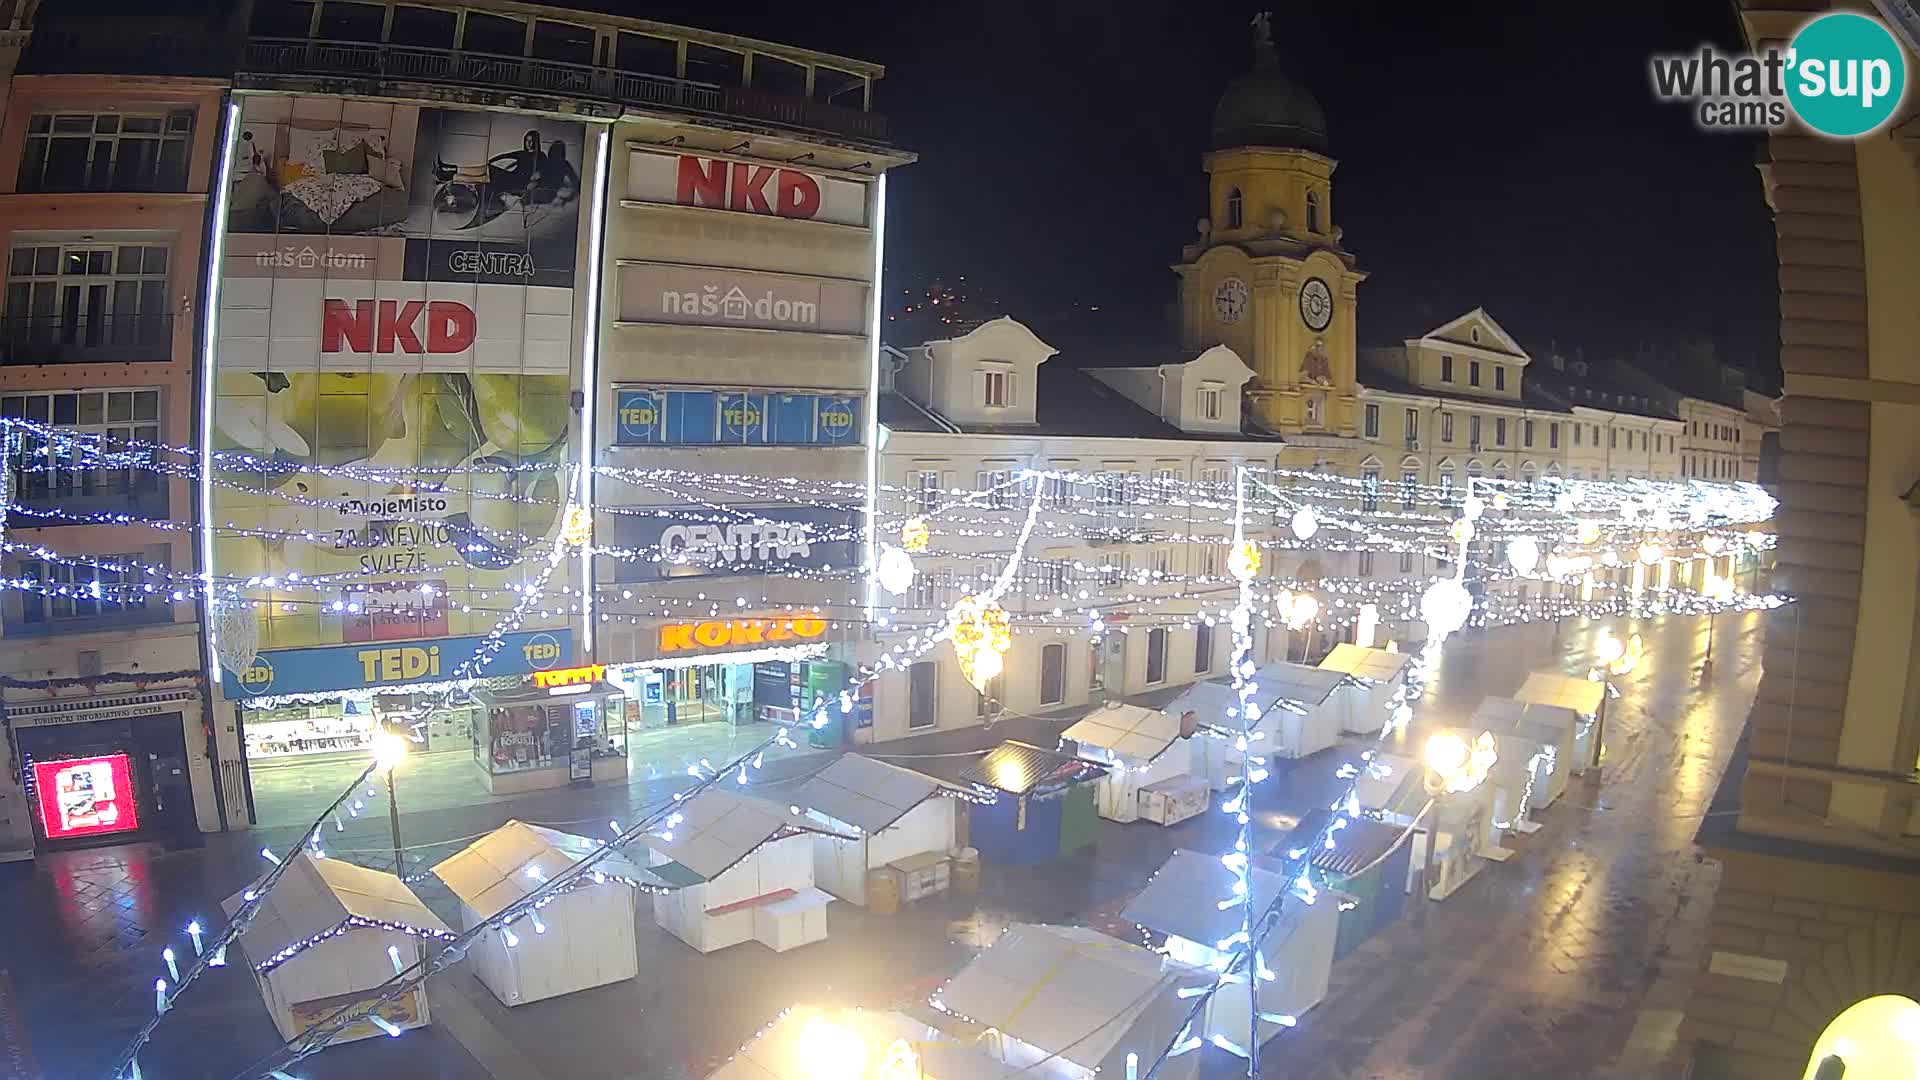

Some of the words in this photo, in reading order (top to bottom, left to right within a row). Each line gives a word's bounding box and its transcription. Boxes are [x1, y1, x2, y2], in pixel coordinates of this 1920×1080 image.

[676, 154, 821, 219] NKD
[256, 246, 295, 269] naš
[319, 247, 367, 269] dom
[448, 250, 536, 278] CENTRA
[661, 285, 719, 317] naš
[754, 290, 817, 323] dom
[321, 297, 478, 354] NKD
[620, 407, 658, 425] TEDi
[724, 409, 760, 426] TEDi
[339, 497, 447, 516] #TvojeMisto
[334, 529, 359, 549] ZA
[366, 525, 450, 548] DNEVNO
[660, 524, 811, 563] CENTRA
[360, 547, 427, 576] SVJEŽE
[659, 612, 828, 653] KORZO
[358, 645, 440, 683] TEDi
[523, 642, 561, 660] TEDi
[533, 663, 606, 688] TOMMY
